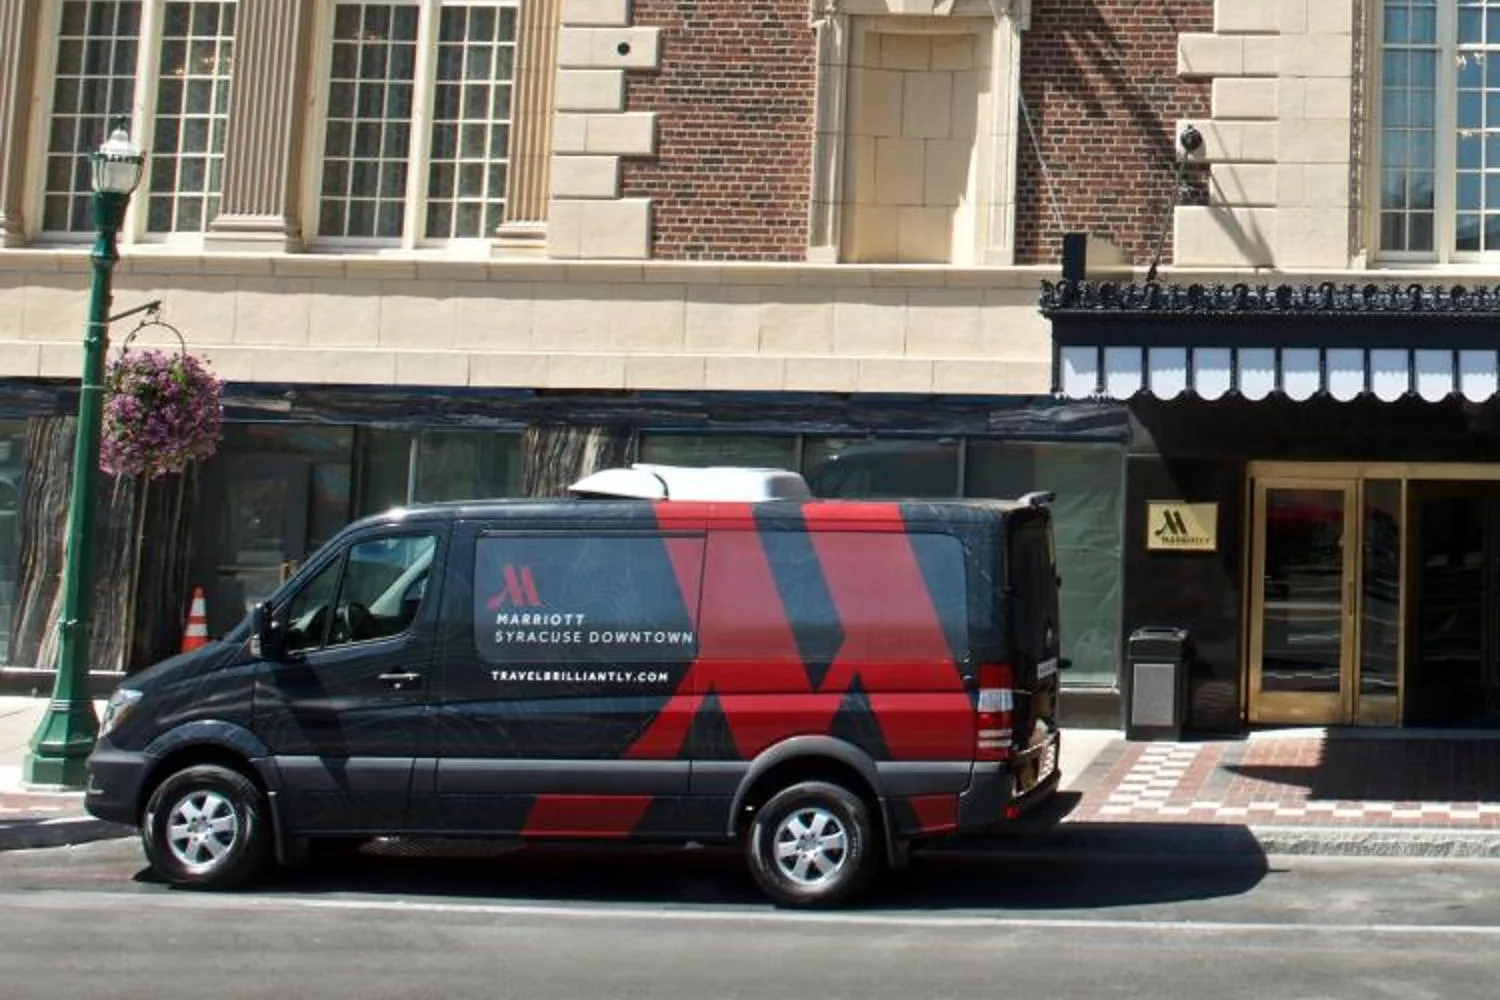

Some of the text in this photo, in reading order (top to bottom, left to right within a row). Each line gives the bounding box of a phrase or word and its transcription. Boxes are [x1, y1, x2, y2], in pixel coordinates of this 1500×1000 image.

[496, 613, 586, 626] MARRIOTT
[495, 630, 693, 645] SYRACUSE DOWNTOWN
[491, 670, 669, 682] TRAVELBRILLIANTLY.COM
